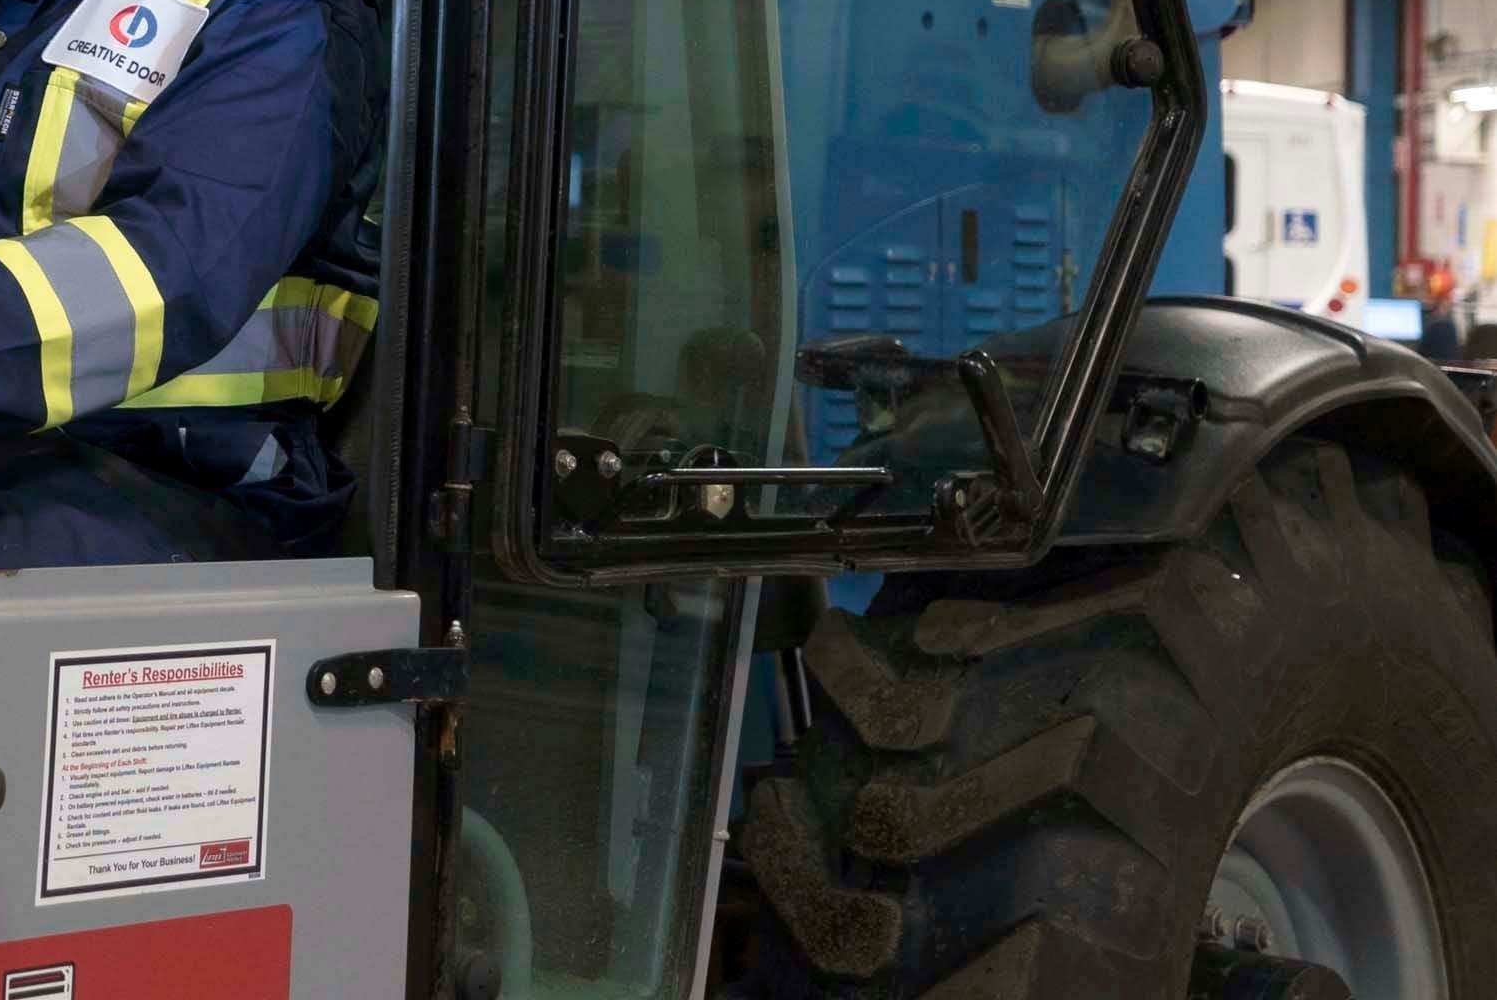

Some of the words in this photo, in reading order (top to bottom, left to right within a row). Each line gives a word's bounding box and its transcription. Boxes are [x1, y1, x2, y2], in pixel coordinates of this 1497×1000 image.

[67, 39, 127, 69] CREATIVE
[126, 60, 166, 87] DOOR
[83, 669, 138, 686] Renter's
[143, 663, 244, 682] Responsibilities
[88, 863, 112, 874] Thank
[113, 862, 127, 871] You
[129, 860, 140, 870] for
[141, 858, 158, 868] Your
[159, 854, 196, 866] Business!
